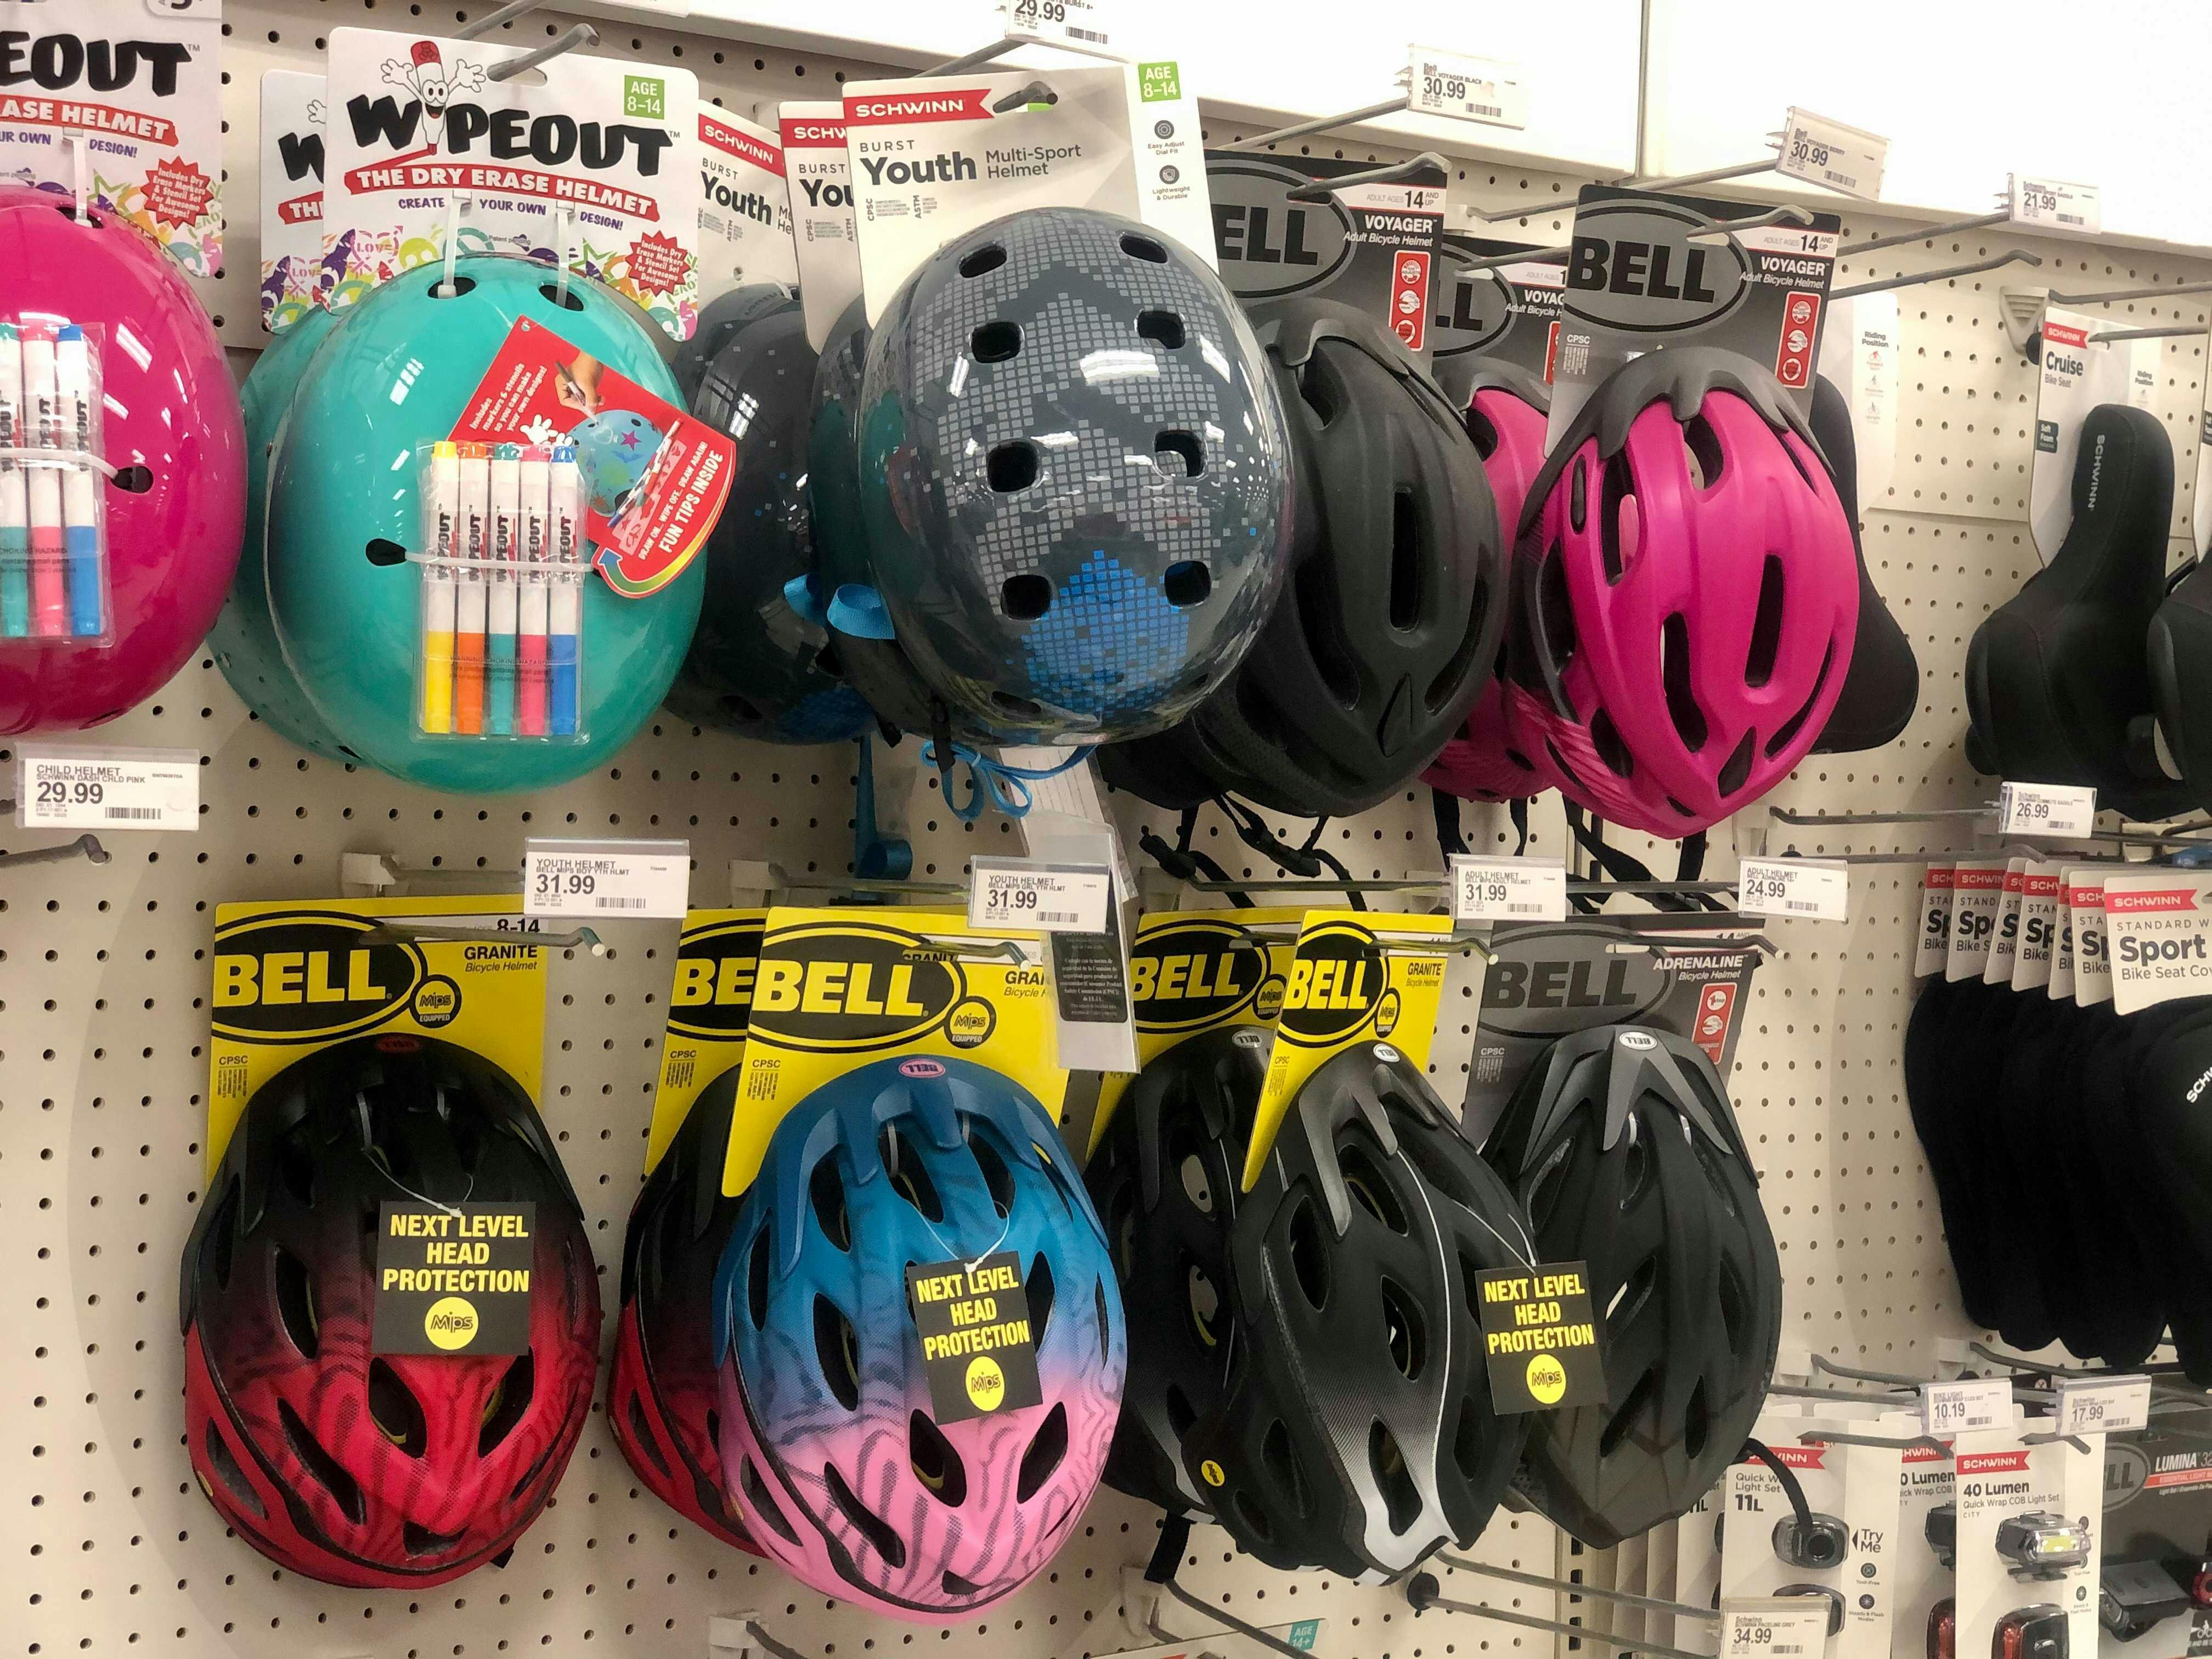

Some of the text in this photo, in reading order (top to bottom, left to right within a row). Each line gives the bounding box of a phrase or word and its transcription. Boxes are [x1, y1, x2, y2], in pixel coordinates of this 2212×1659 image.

[1015, 0, 1065, 22] 29.99
[1146, 66, 1172, 80] AGE
[630, 82, 657, 97] AGE
[1143, 81, 1177, 98] 8-14
[1423, 76, 1465, 100] 30.99
[627, 97, 662, 115] 8-14
[855, 99, 964, 117] SCHWINN
[61, 104, 169, 140] HELMET
[347, 94, 674, 177] WIPEOUT
[19, 132, 138, 158] OWN DESIGN!
[704, 125, 774, 164] SCHWINN
[860, 140, 915, 152] BURST
[1148, 140, 1184, 150] Easy Adjust
[985, 144, 1081, 163] Multi-Sport
[1791, 141, 1829, 167] 30.99
[702, 157, 738, 180] BURST
[799, 164, 845, 173] BURST
[860, 151, 977, 185] Youth
[988, 162, 1048, 179] Helmet
[357, 167, 653, 216] THE DRY ERASE HELMET
[701, 171, 771, 225] Youth
[1152, 185, 1190, 195] Lightweight
[1404, 190, 1423, 208] 14
[2024, 192, 2056, 211] 21.99
[398, 197, 623, 230] CREATE YOUR OWN DESIGN!
[866, 198, 874, 221] CPSC
[1364, 214, 1433, 234] VOYAGER
[1344, 231, 1433, 246] Adult Bicycle Helmet
[1800, 235, 1819, 253] 14
[641, 240, 683, 259] Includes Dry
[645, 257, 668, 270] Stencil
[656, 251, 684, 267] Markers
[1760, 256, 1825, 276] VOYAGER
[647, 267, 679, 282] Awesome
[1567, 236, 1716, 303] BELL
[641, 273, 669, 287] Designs!
[1739, 271, 1825, 289] Adult Bicycle Helmet
[1567, 335, 1590, 345] CPSC
[1861, 338, 1889, 348] Position
[1864, 330, 1886, 342] Riding
[2048, 327, 2080, 342] SCHWINN
[2046, 351, 2084, 376] Cruise
[2087, 434, 2106, 509] SCHWINN
[658, 449, 724, 553] FUN TIPS INSIDE
[36, 764, 121, 776] CHILD HELMET
[36, 773, 75, 781] SCHWINN
[77, 774, 100, 782] DASH
[101, 774, 125, 783] CHLD
[37, 781, 103, 804] 29.99
[2017, 802, 2049, 819] 26.99
[537, 858, 616, 869] YOUTH HELMET
[989, 874, 1055, 886] YOUTH HELMET
[1747, 867, 1798, 879] ADULT HELMET
[535, 874, 595, 895] 31.99
[1465, 884, 1506, 901] 31.99
[1746, 879, 1786, 898] 24.99
[988, 889, 1037, 909] 31.99
[2114, 896, 2181, 907] SCHWINN
[2117, 919, 2192, 932] STANDARD
[464, 944, 538, 961] GRANITE
[1957, 940, 1980, 952] Bike
[2023, 948, 2049, 960] Bike
[2119, 934, 2207, 967] Sport
[465, 961, 538, 973] Bicycle Helmet
[1407, 962, 1442, 977] GRANITE
[1652, 955, 1743, 970] ADRENALINE
[213, 949, 386, 1007] BELL
[1129, 953, 1240, 1002] BELL
[1678, 970, 1742, 982] Bicycle Helmet
[2121, 966, 2186, 980] Bike Seat
[752, 960, 923, 1016] BELL
[1003, 987, 1039, 997] Bicycle
[1283, 959, 1368, 1010] BELL
[1481, 960, 1637, 1008] BELL
[952, 1034, 983, 1043] EQUIPPED
[219, 1055, 249, 1065] CPSC
[670, 1051, 697, 1059] CPSC
[1274, 1056, 1290, 1064] CPSC
[1481, 1047, 1505, 1056] CPSC
[752, 1059, 781, 1068] CPSC
[905, 1064, 939, 1073] BELL
[390, 1214, 529, 1238] NEXT LEVEL
[426, 1242, 490, 1265] HEAD
[382, 1268, 530, 1293] PROTECTION
[916, 1266, 1019, 1303] NEXT LEVEL
[1484, 1273, 1585, 1303] NEXT LEVEL
[950, 1297, 997, 1327] HEAD
[1514, 1301, 1561, 1326] HEAD
[430, 1311, 473, 1333] Mips
[923, 1319, 1031, 1361] PROTECTION
[1487, 1323, 1595, 1355] PROTECTION
[1934, 1402, 1965, 1419] 10.19
[2072, 1405, 2103, 1422] 17.99
[1963, 1457, 2017, 1469] SCHWINN
[2155, 1452, 2197, 1472] LUMINA
[1736, 1472, 1765, 1483] Quick
[1912, 1472, 1955, 1485] Lumen
[1735, 1482, 1781, 1493] Light Set
[1914, 1486, 1953, 1497] Wrap COB
[1963, 1481, 2030, 1498] 40 Lumen
[1735, 1494, 1764, 1513] 11L
[1963, 1493, 2060, 1509] Quick Wrap COB Light Set
[1862, 1529, 1884, 1542] Try
[1860, 1541, 1882, 1553] Me
[1294, 1626, 1314, 1635] AGE
[1734, 1628, 1772, 1644] 34.99
